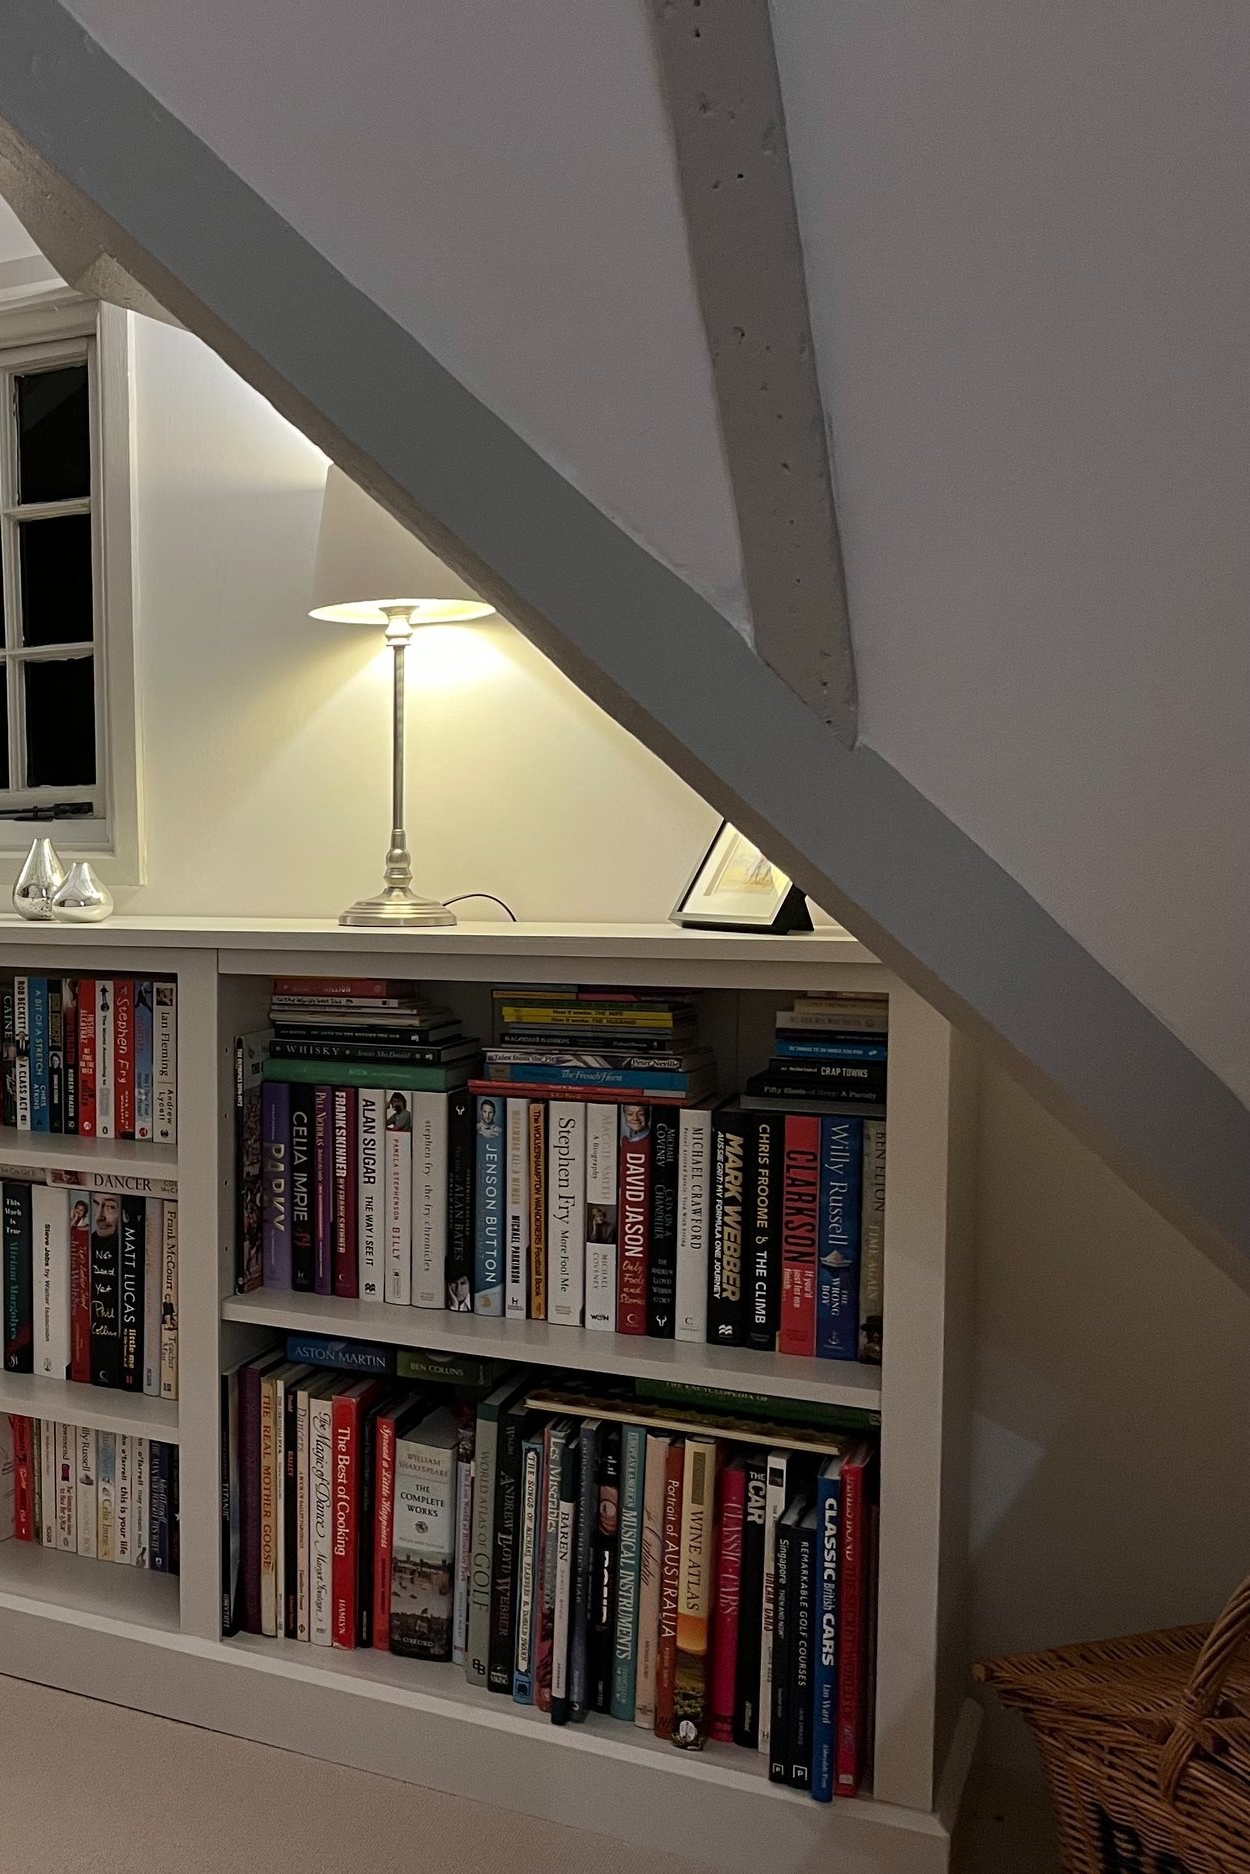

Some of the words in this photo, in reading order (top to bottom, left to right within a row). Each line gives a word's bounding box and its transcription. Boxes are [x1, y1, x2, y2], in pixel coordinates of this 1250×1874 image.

[3, 995, 12, 1039] CAINE
[17, 997, 26, 1029] BECKETT
[116, 997, 129, 1054] Stephen
[161, 1011, 169, 1028] Ian
[114, 1059, 129, 1084] Fry
[160, 1033, 169, 1076] Fleming
[285, 1045, 341, 1056] WHISKY
[19, 1070, 27, 1094] CLASS
[19, 1096, 28, 1111] ACT
[335, 1091, 347, 1127] FRANK
[362, 1098, 376, 1135] ALAN
[293, 1111, 308, 1165] CELIA
[335, 1127, 347, 1177] SKINNER
[553, 1117, 575, 1188] Stephen
[691, 1127, 703, 1180] MICHAEL
[757, 1123, 770, 1164] CHRIS
[826, 1122, 850, 1175] Willy
[362, 1138, 376, 1184] SUGAR
[485, 1143, 497, 1210] JENSON
[627, 1152, 644, 1201] DAVID
[723, 1132, 743, 1202] MARK
[293, 1172, 308, 1222] IMRIE
[553, 1194, 575, 1224] Fry
[690, 1185, 703, 1249] CRAWFORD
[756, 1168, 770, 1228] FROOME
[783, 1150, 817, 1264] CLARKSON
[828, 1181, 849, 1245] Russell
[166, 1210, 176, 1240] Frank
[560, 1229, 569, 1254] More
[624, 1204, 644, 1257] JASON
[9, 1240, 20, 1281] Miriam
[124, 1227, 136, 1269] MATT
[166, 1243, 176, 1290] McCourt
[485, 1216, 497, 1282] BUTTON
[560, 1256, 569, 1276] Fool
[721, 1205, 743, 1301] WEBBER
[755, 1250, 767, 1277] THE
[124, 1273, 136, 1323] LUCAS
[560, 1278, 569, 1292] Me
[754, 1281, 767, 1324] CLIMB
[822, 1284, 830, 1305] BOY
[830, 1277, 841, 1316] WRONG
[9, 1283, 20, 1340] Margolyes
[129, 1353, 135, 1369] me
[168, 1335, 176, 1370] Teacher
[294, 1346, 335, 1360] ASTON
[337, 1351, 386, 1367] MARTIN
[410, 1362, 427, 1371] BEN
[428, 1364, 464, 1377] COLLINS
[263, 1395, 272, 1417] THE
[81, 1442, 91, 1472] Russell
[263, 1425, 272, 1458] REAL
[337, 1426, 350, 1452] The
[336, 1454, 350, 1484] Best
[415, 1483, 431, 1494] THE
[263, 1465, 272, 1518] MOTHER
[337, 1486, 349, 1500] of
[400, 1491, 446, 1508] COMPLETE
[406, 1504, 439, 1517] WORKS
[499, 1470, 515, 1531] ANDREW
[666, 1479, 680, 1520] Portrait
[746, 1480, 766, 1525] CAR
[263, 1524, 272, 1568] GOOSE
[334, 1501, 349, 1556] Cooking
[619, 1508, 637, 1567] MUSICAL
[666, 1524, 679, 1537] of
[689, 1511, 703, 1555] WINE
[824, 1498, 837, 1580] CLASSIC
[497, 1531, 513, 1574] LLOYD
[778, 1539, 790, 1584] Singapore
[800, 1541, 809, 1607] REMARKABLE
[495, 1576, 511, 1637] WEBBER
[661, 1540, 679, 1637] AUSTRALIA
[686, 1559, 702, 1611] ATLAS
[822, 1582, 835, 1611] British
[338, 1599, 346, 1634] HAMLYN
[615, 1569, 636, 1660] INSTRUMENTS
[799, 1610, 808, 1637] GOLF
[822, 1612, 835, 1666] CARS
[797, 1640, 808, 1686] COURSES
